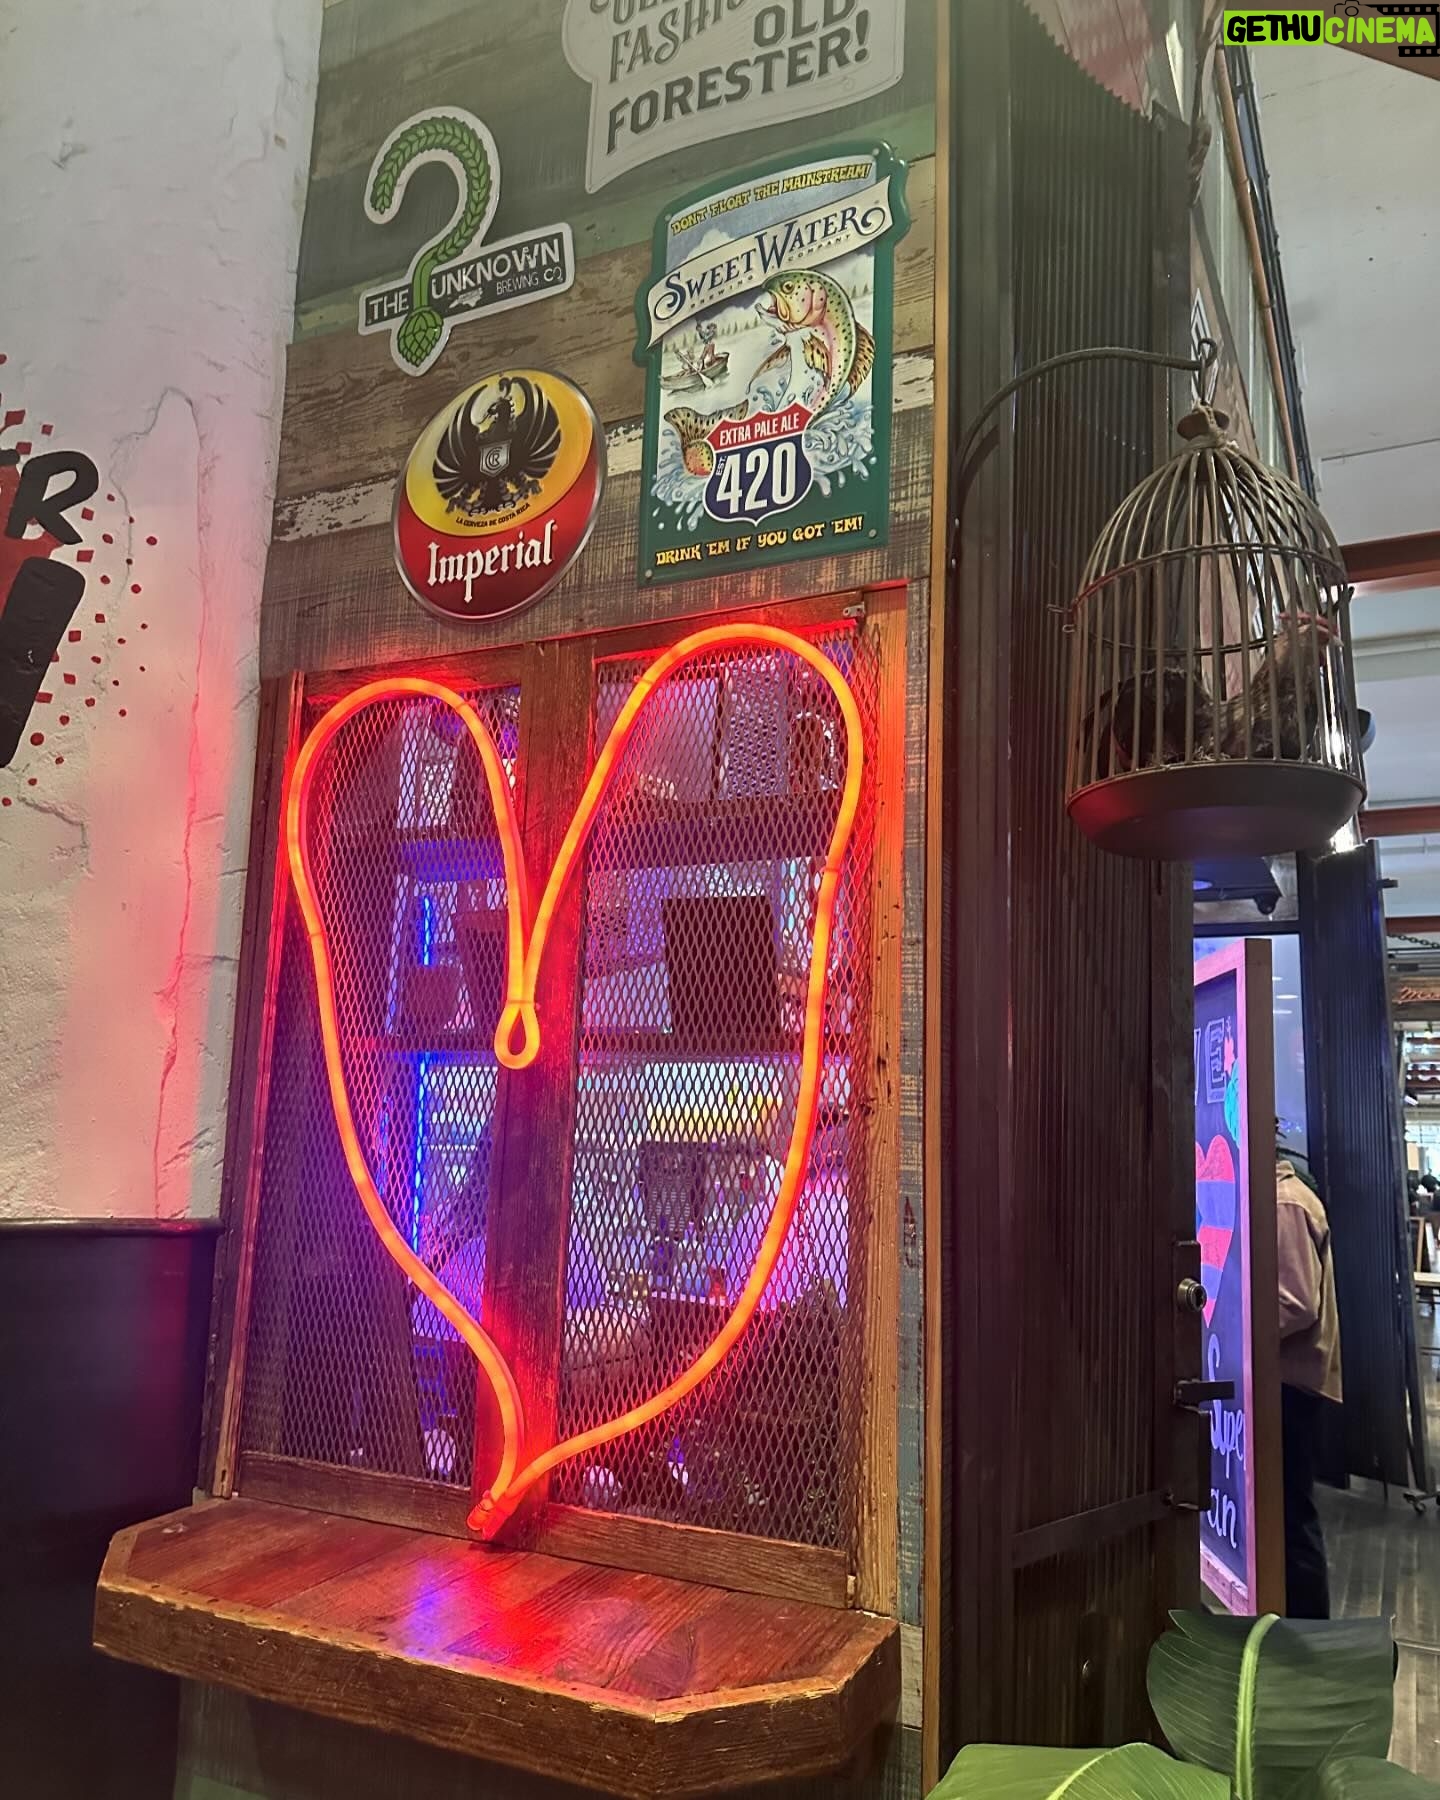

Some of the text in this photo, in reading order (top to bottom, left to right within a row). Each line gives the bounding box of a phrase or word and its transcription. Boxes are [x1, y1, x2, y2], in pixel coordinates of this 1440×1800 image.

[753, 0, 854, 48] OLD
[606, 9, 871, 156] FORESTER!
[671, 162, 872, 236] DON'T FLOAT THE MAINSTREAM!
[431, 239, 560, 299] UNKNOWN
[496, 272, 539, 296] BREWING
[369, 289, 410, 320] THE
[719, 412, 800, 447] EXTRA PALE ALE
[716, 441, 796, 515] 420
[463, 520, 488, 528] CERVEZA
[497, 513, 516, 525] COSTA
[516, 502, 531, 516] RICA
[427, 519, 556, 603] Imperial
[655, 545, 702, 566] DRINK
[736, 535, 751, 551] IF
[757, 529, 788, 549] YOU
[792, 523, 825, 542] GOT
